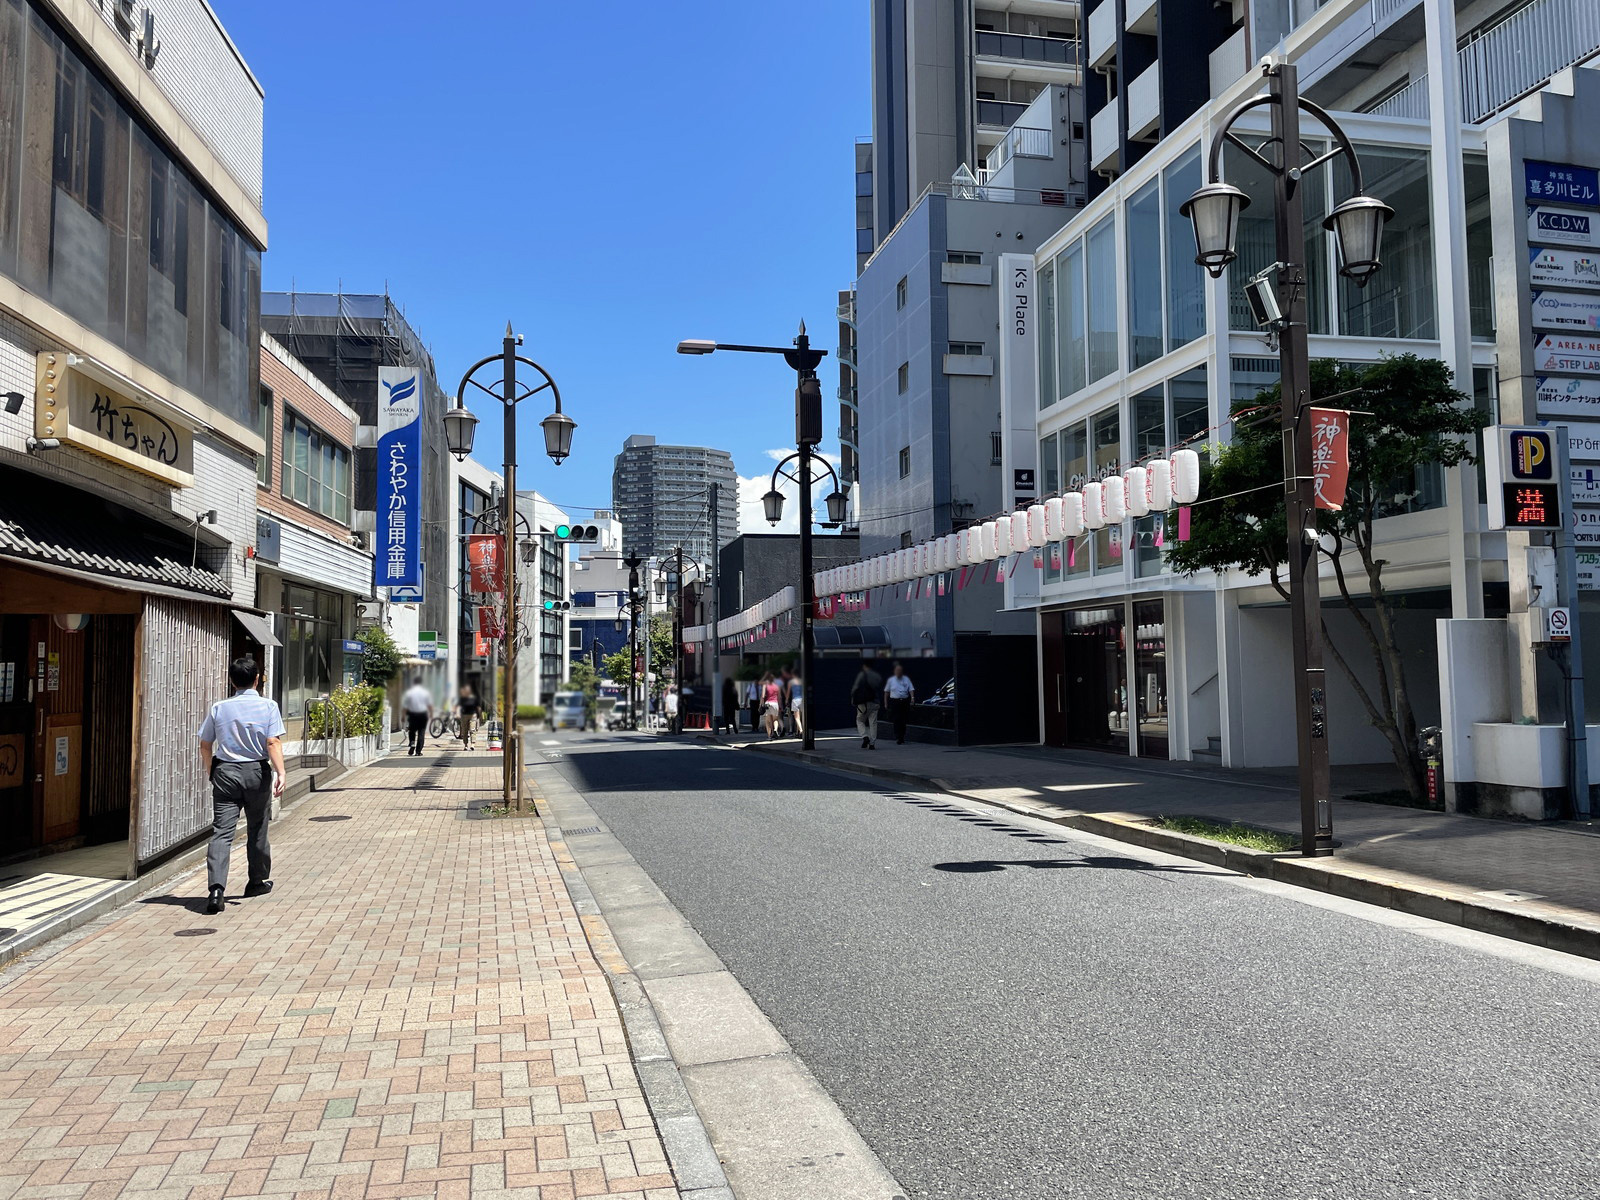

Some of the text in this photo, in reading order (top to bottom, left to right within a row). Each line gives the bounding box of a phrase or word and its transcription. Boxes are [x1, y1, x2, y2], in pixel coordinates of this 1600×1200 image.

[1530, 179, 1594, 199] 喜多川ビル
[1539, 214, 1588, 232] K.C.D.W.
[1015, 268, 1028, 336] K's Place
[1559, 359, 1581, 369] STEP
[90, 392, 179, 466] 竹ちゃん
[1522, 436, 1546, 474] P
[386, 441, 408, 580] さわやか信用金庫
[1516, 489, 1546, 523] 満
[1580, 513, 1600, 523] on
